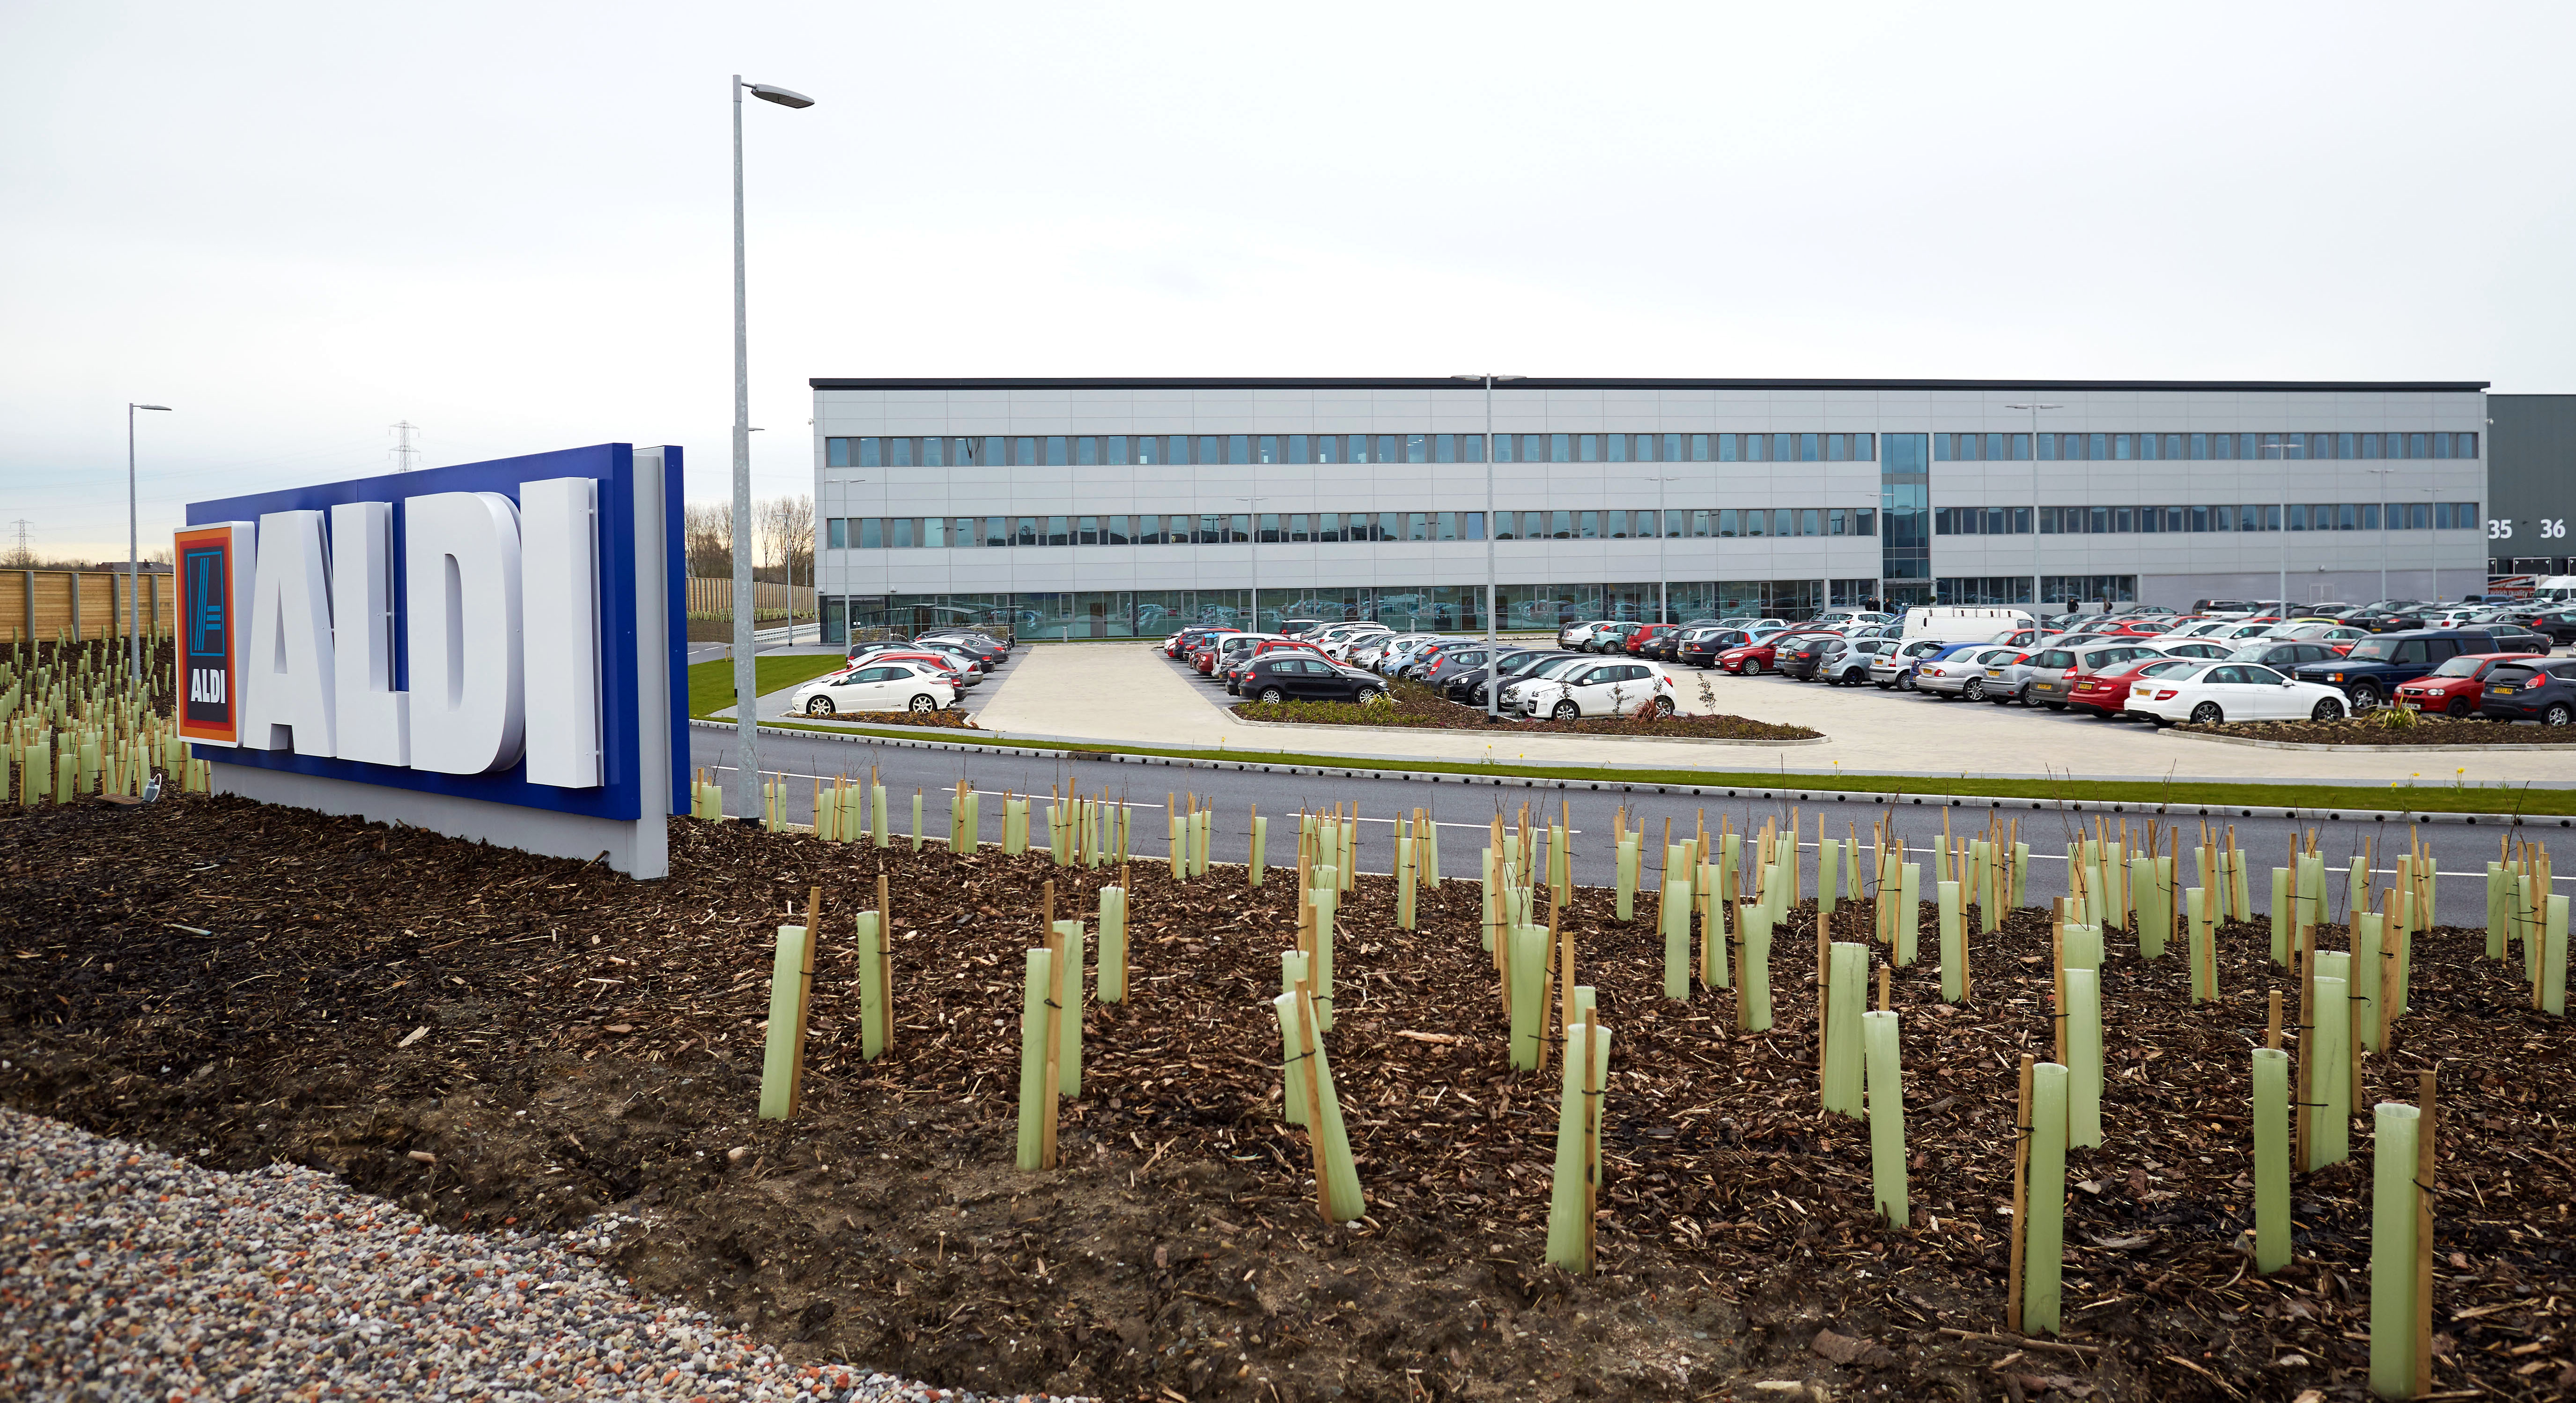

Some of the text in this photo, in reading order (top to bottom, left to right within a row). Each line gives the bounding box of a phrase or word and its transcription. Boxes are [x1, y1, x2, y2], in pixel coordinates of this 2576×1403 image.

[2488, 519, 2512, 539] 35
[2540, 518, 2566, 539] 36
[243, 477, 599, 788] ALDI
[191, 668, 225, 704] ALDI
